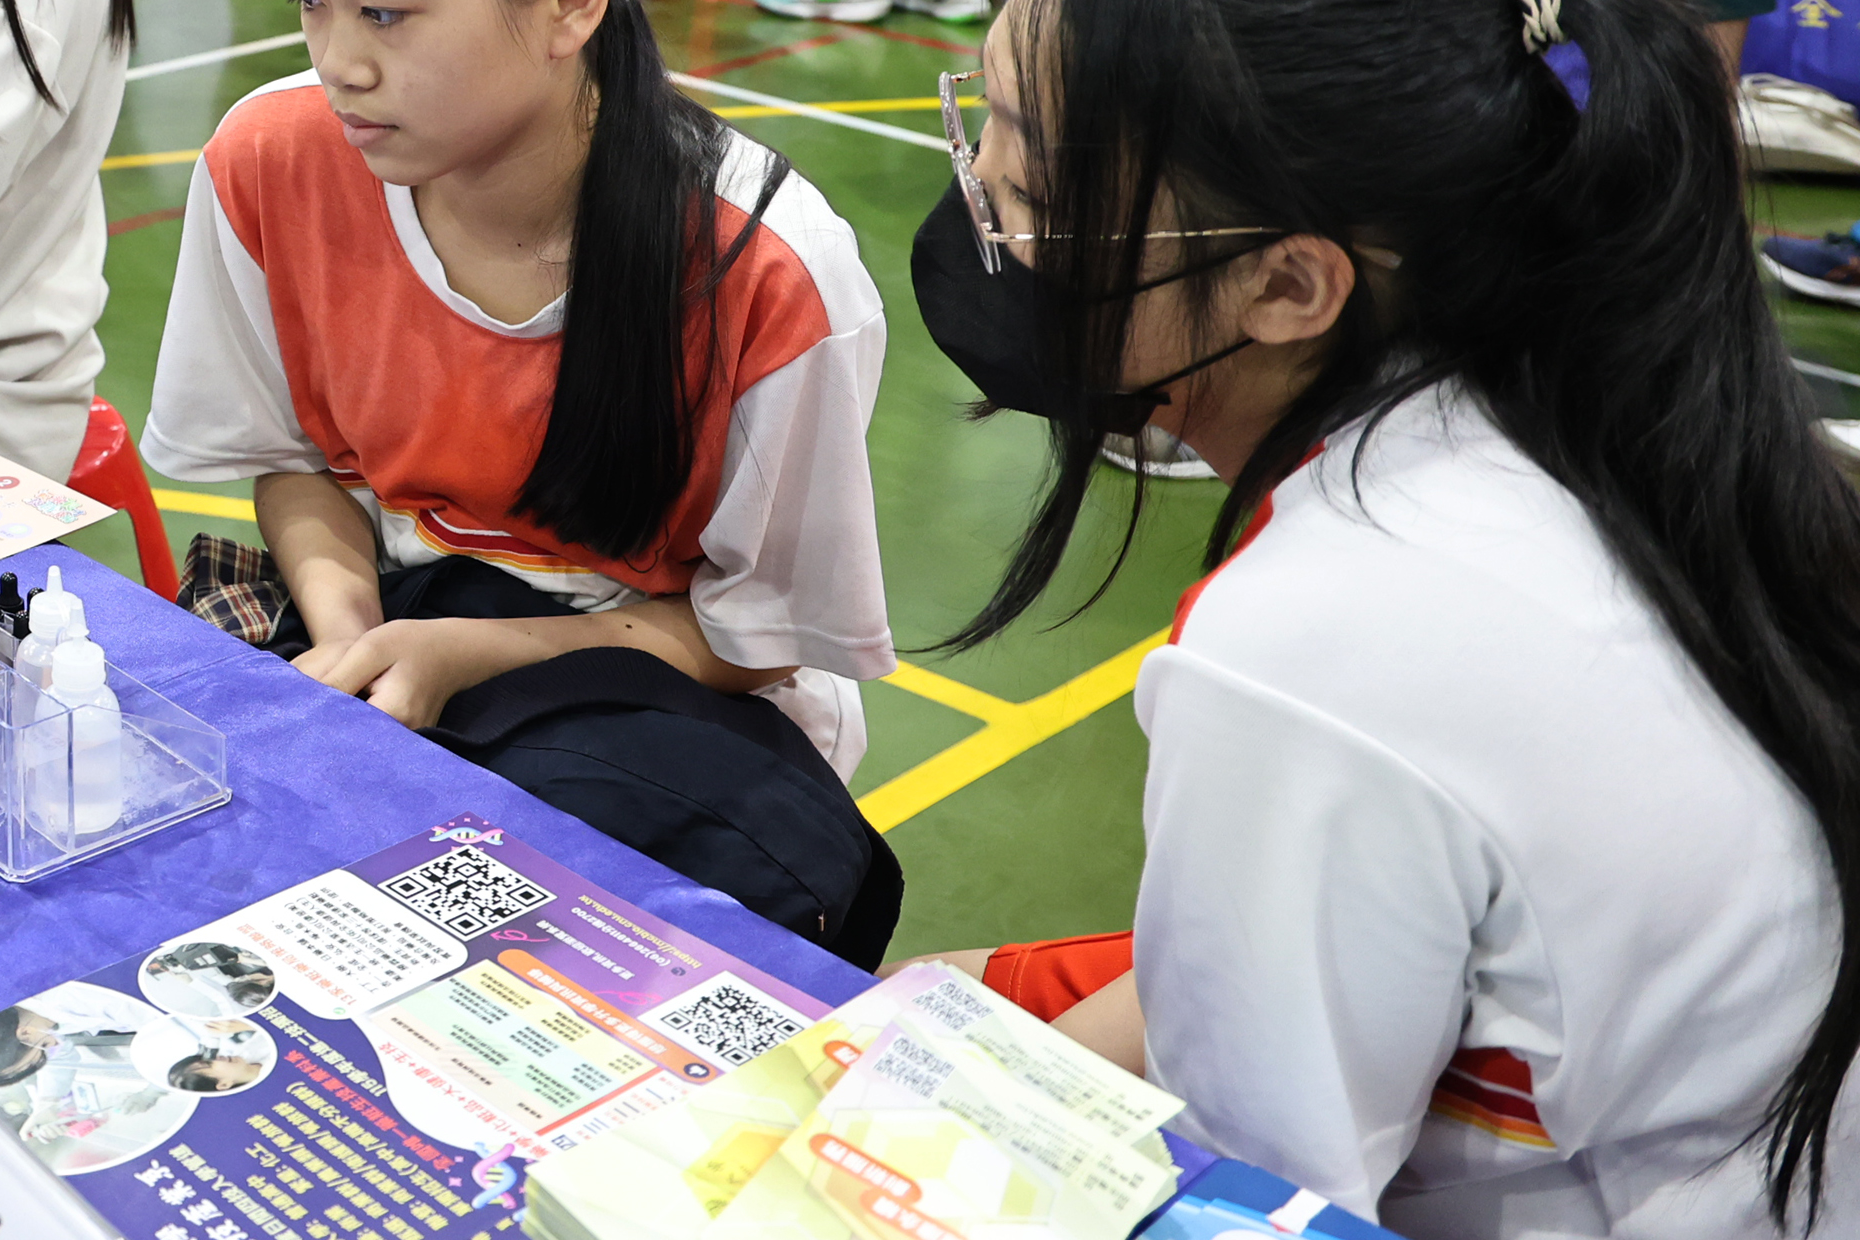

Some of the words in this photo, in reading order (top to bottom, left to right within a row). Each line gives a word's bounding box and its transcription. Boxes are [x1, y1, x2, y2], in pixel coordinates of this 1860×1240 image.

[574, 894, 705, 969] https://mcbio.cnu.edu.tw
[277, 1048, 459, 1171] 全國唯一藥粧生技產業科系
[239, 1140, 284, 1169] 化工
[238, 1172, 313, 1221] 普通高中
